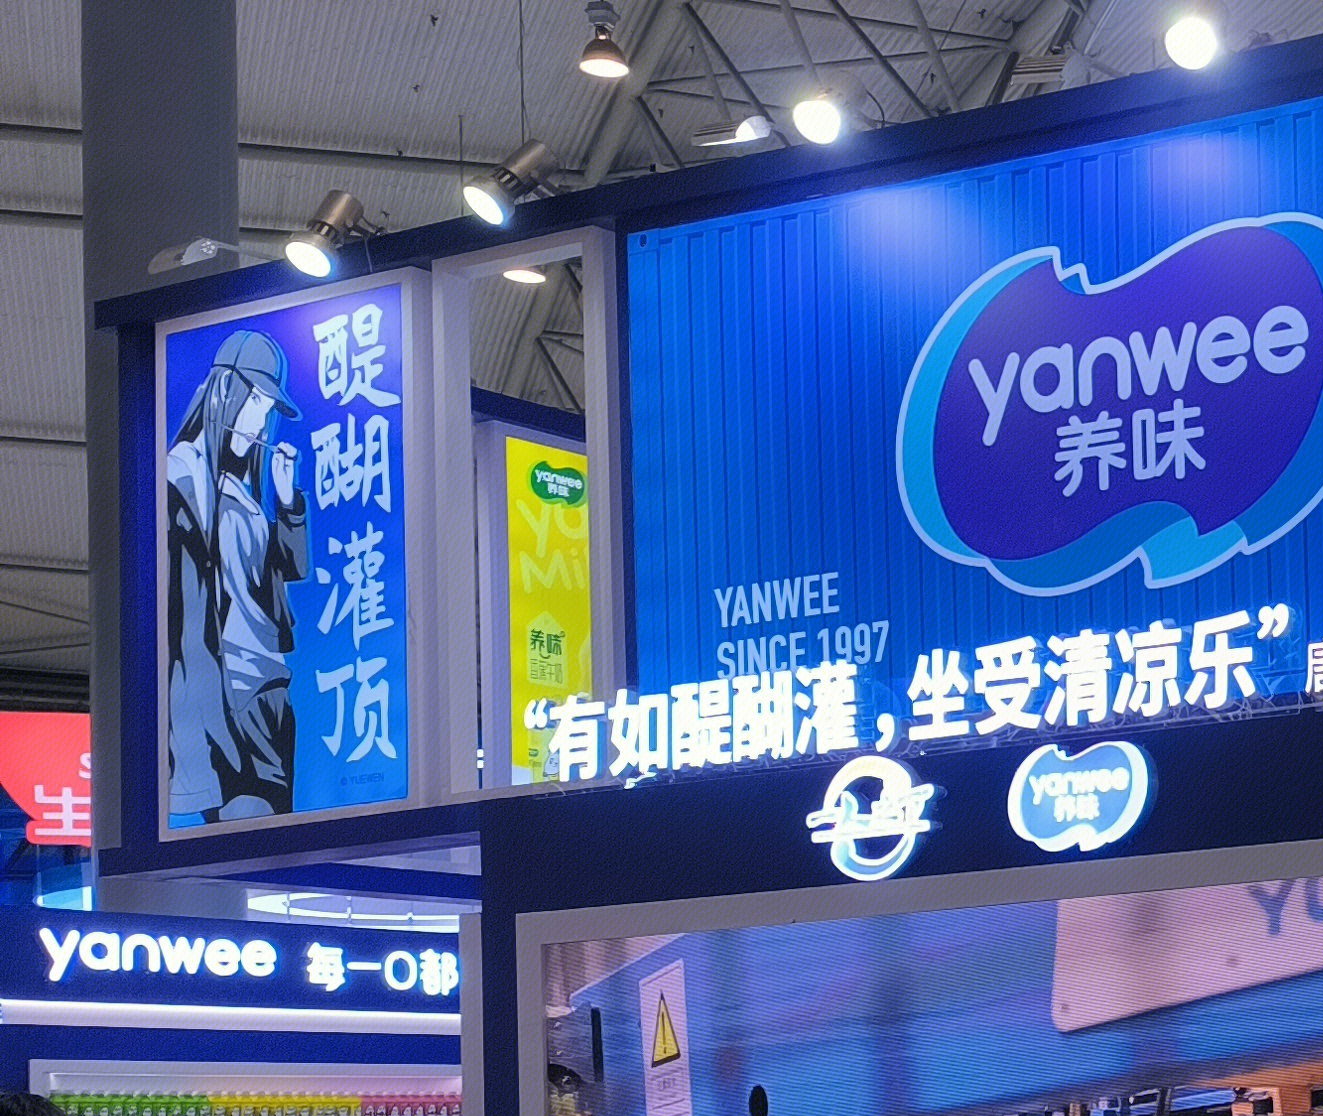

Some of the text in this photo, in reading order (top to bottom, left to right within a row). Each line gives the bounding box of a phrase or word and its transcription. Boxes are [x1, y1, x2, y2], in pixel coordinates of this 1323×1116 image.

[968, 304, 1309, 447] yanwee
[1054, 398, 1207, 497] 养味
[310, 302, 402, 763] 醍醐灌顶
[714, 573, 840, 628] YANWEE
[716, 621, 890, 682] SINCE 1997
[1028, 767, 1131, 806] yanwee
[38, 927, 278, 982] yanwee
